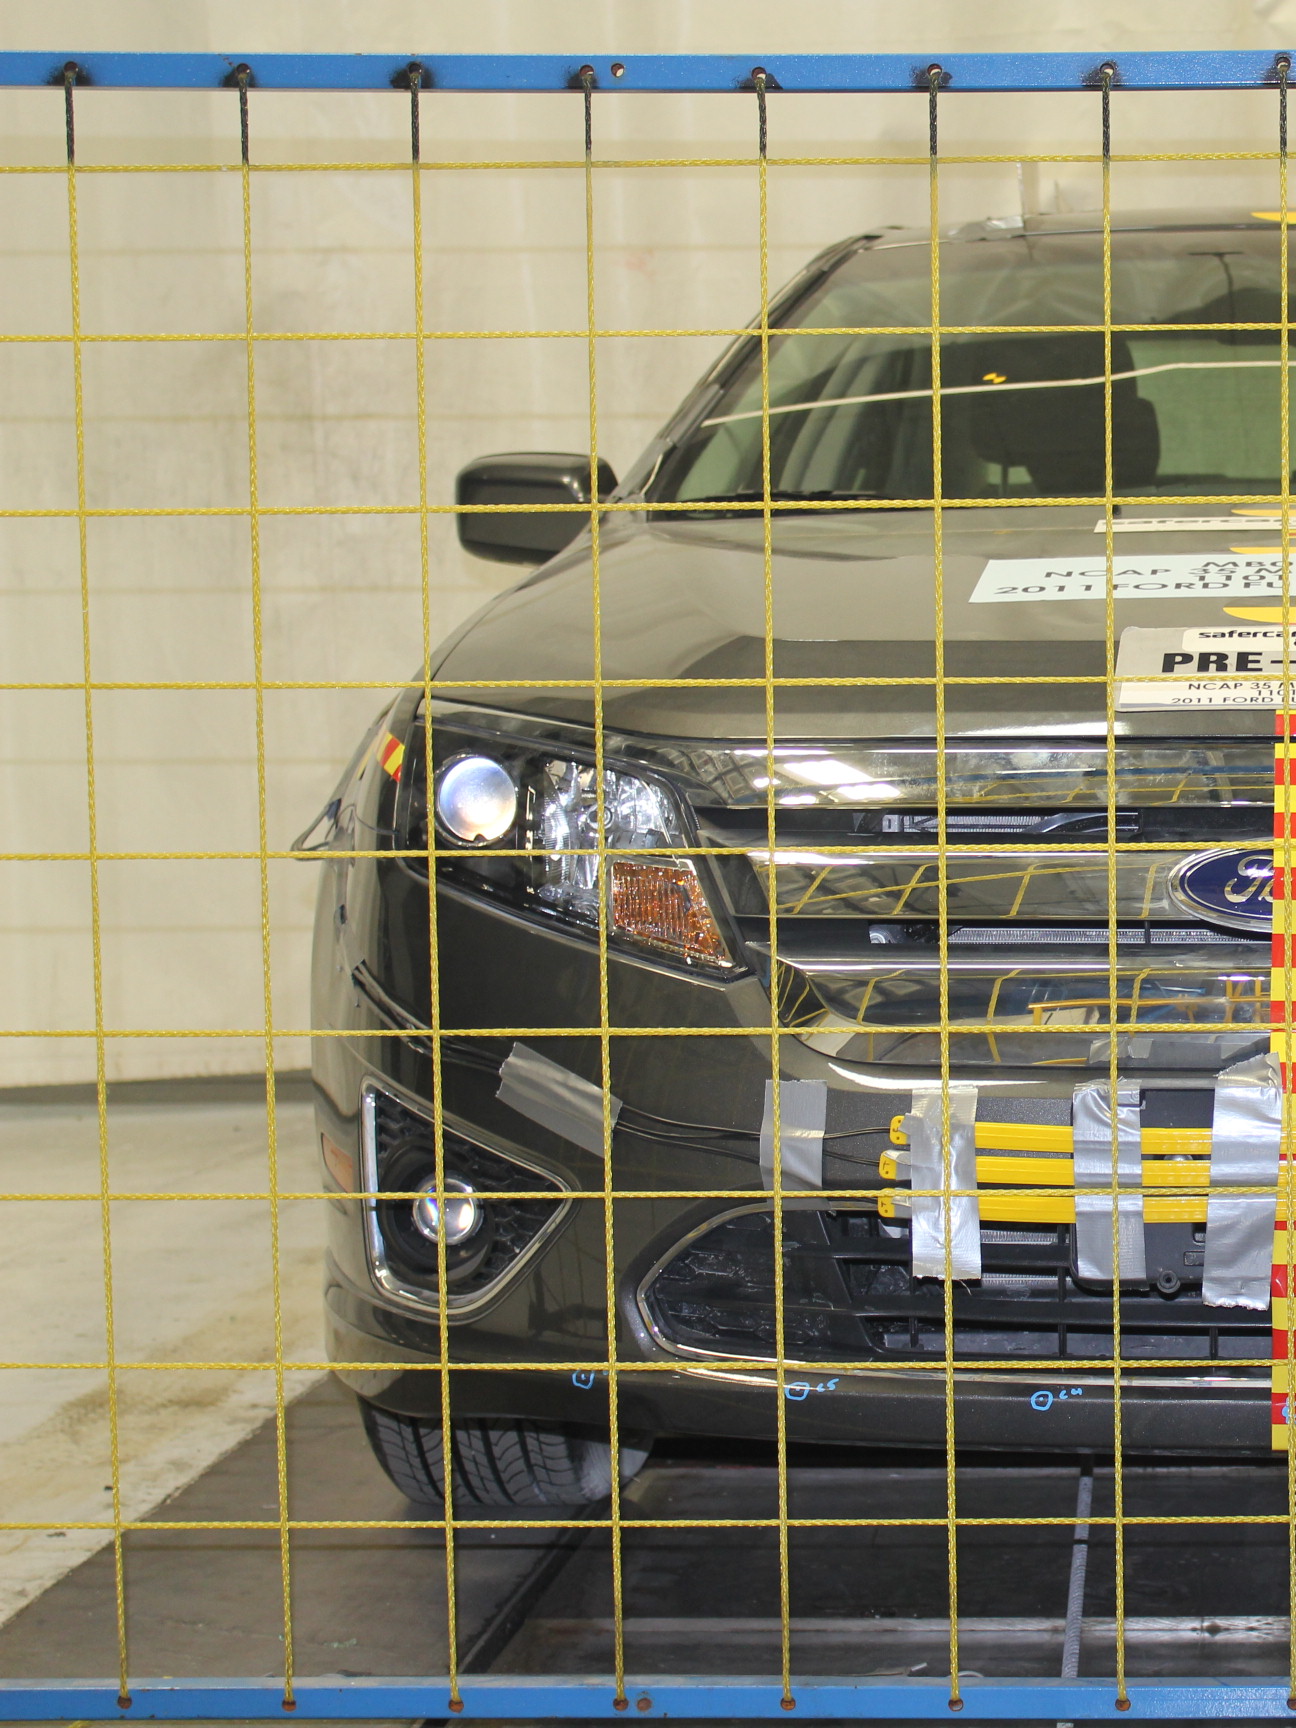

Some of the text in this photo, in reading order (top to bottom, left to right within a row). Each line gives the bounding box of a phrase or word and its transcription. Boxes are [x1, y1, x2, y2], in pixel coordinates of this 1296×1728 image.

[1044, 569, 1171, 578] NCAP
[995, 584, 1093, 594] 2011
[1112, 582, 1230, 591] FORD
[1188, 682, 1243, 690] NCAP
